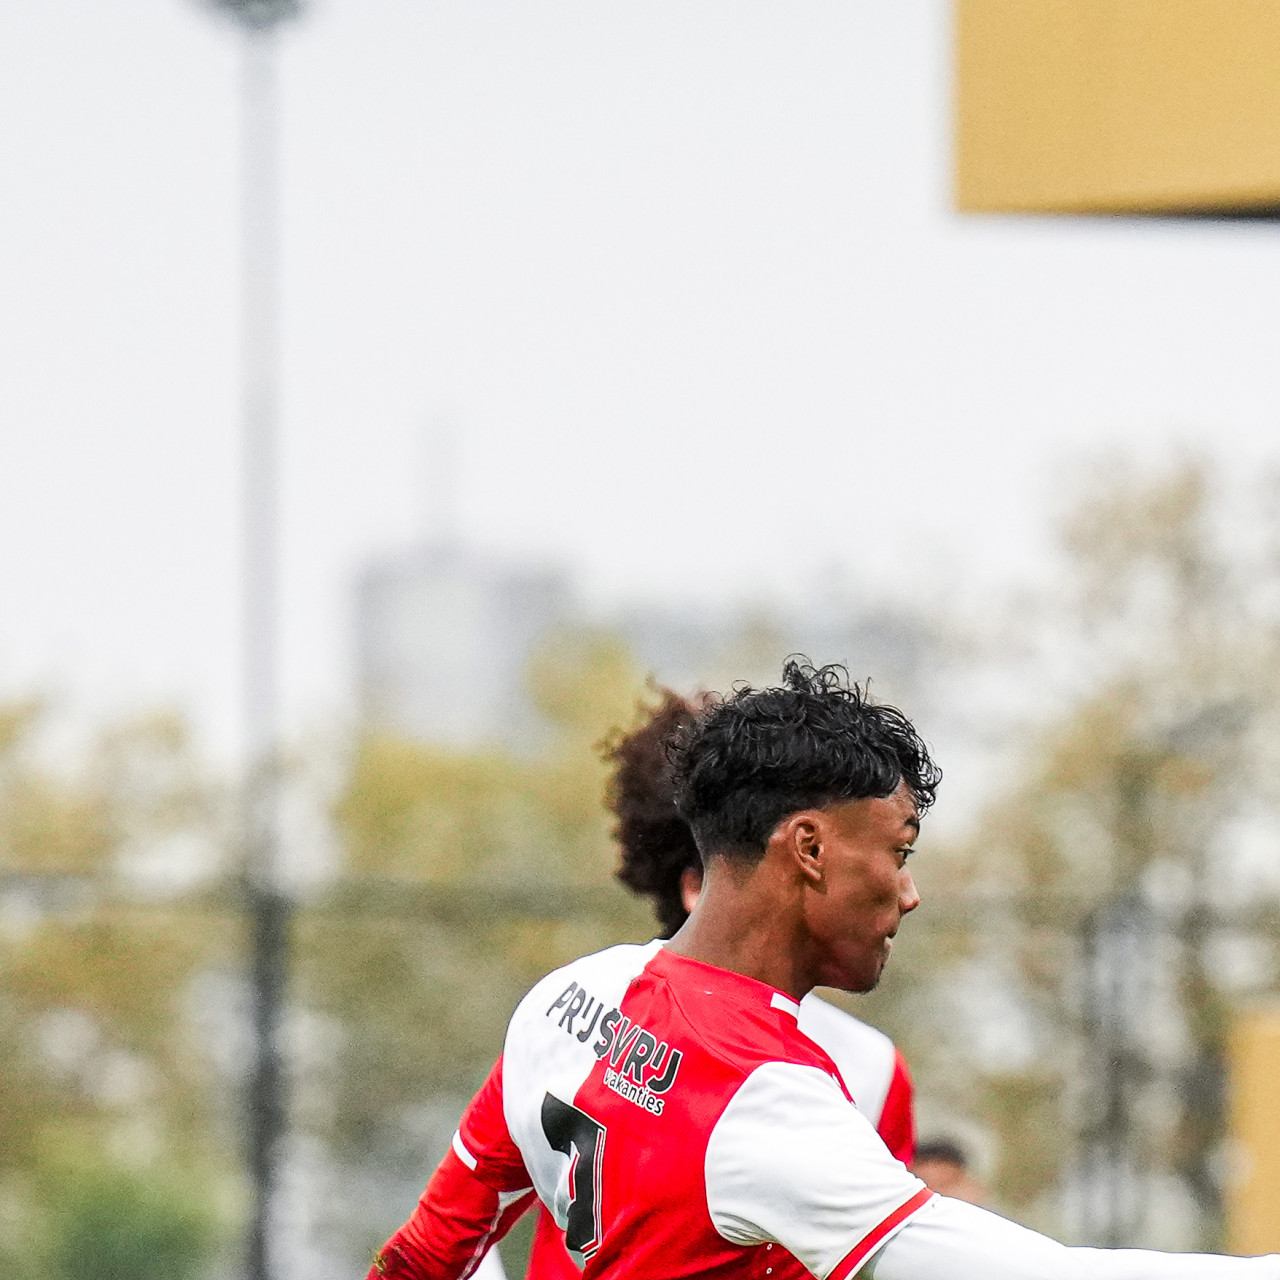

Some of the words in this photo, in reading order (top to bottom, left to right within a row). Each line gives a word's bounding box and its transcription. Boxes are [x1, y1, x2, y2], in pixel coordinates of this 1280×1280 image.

[546, 982, 682, 1092] PRIJSVRIJ
[603, 1067, 665, 1115] vakanties
[541, 1091, 606, 1256] 7
